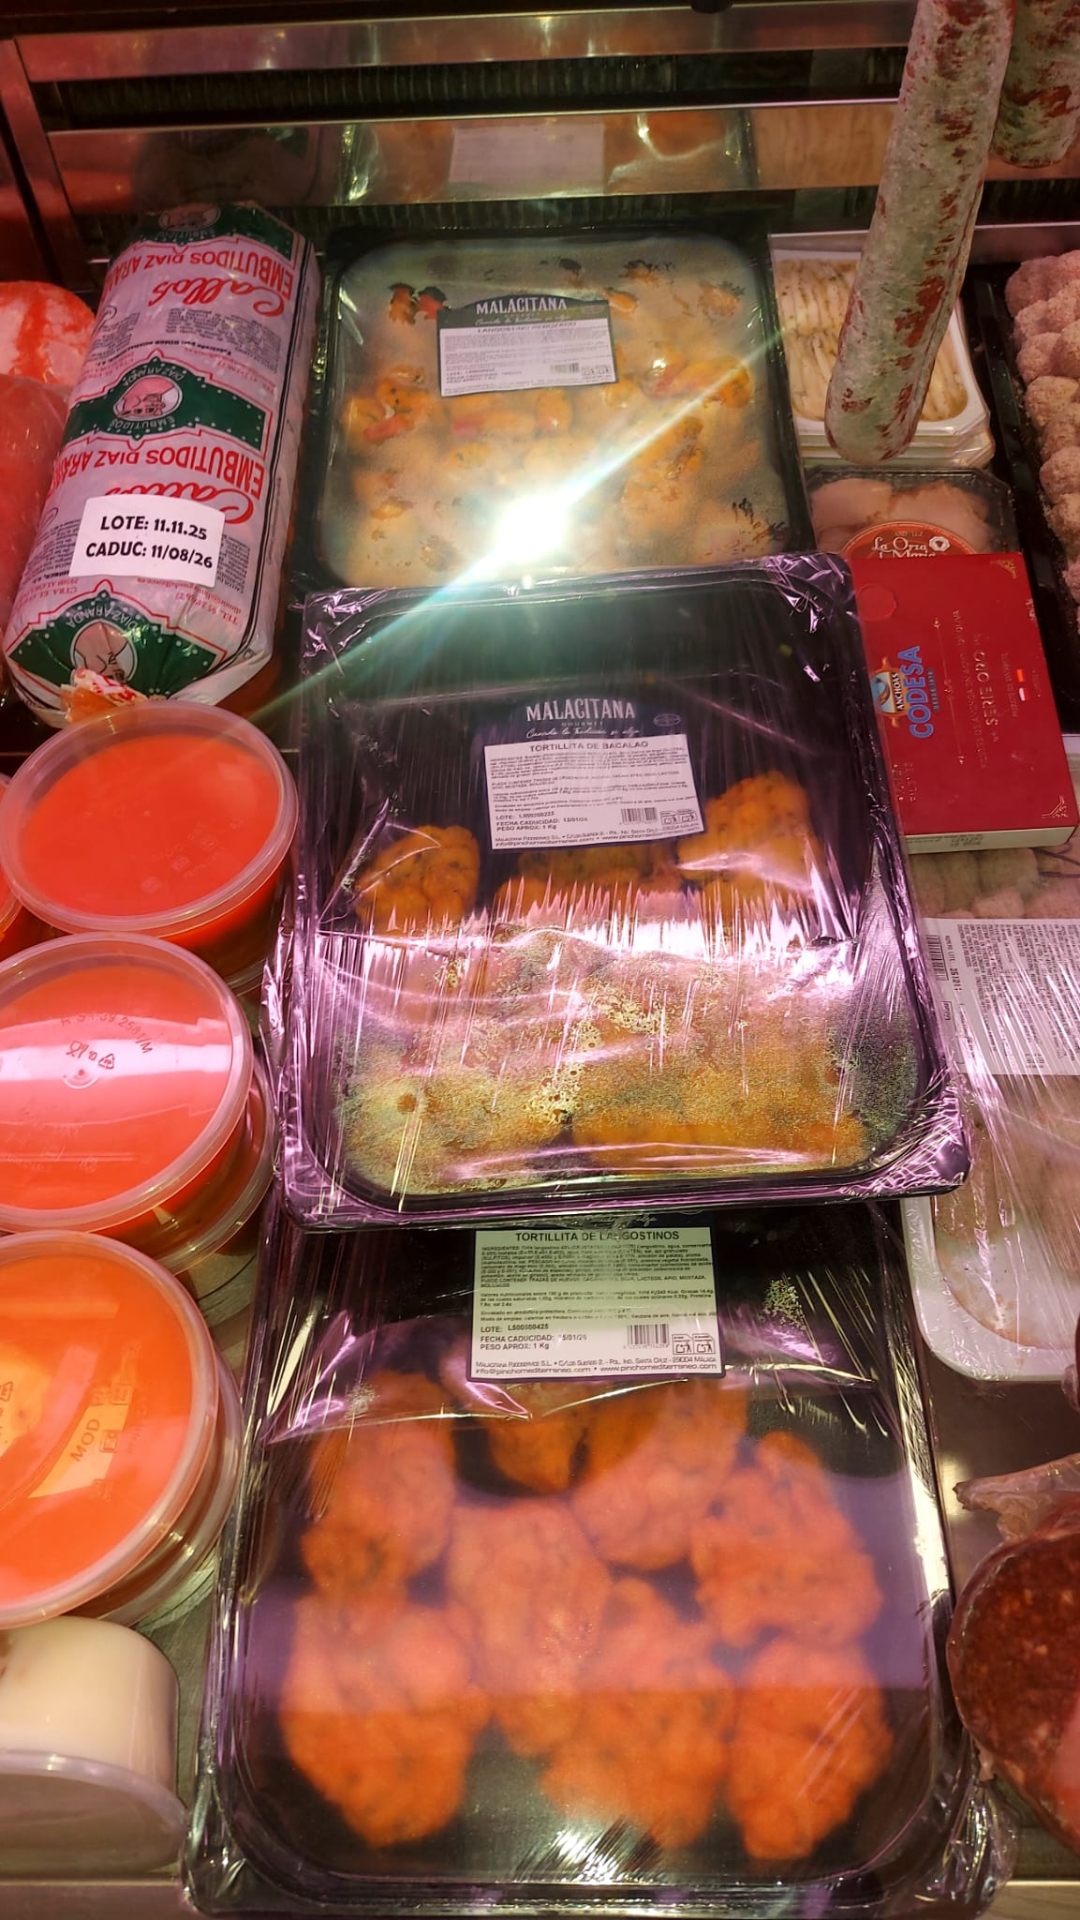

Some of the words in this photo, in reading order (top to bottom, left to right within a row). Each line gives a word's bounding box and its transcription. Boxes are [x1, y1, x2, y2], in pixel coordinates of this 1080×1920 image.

[144, 254, 184, 269] DIAZ
[190, 250, 293, 299] EMBUTIDOS
[148, 278, 285, 317] Callos
[476, 296, 567, 315] MALACITANA
[109, 415, 175, 430] EMBUTIDOS
[95, 449, 140, 469] DIAZ
[145, 447, 265, 500] EMBUTIDOS
[100, 515, 149, 532] LOTE:
[153, 518, 208, 541] 11.11.25
[86, 541, 147, 558] CADUC:
[152, 544, 213, 569] 11/08/26
[872, 536, 888, 551] La
[65, 604, 113, 628] ARANDA
[973, 651, 990, 683] ORO
[888, 671, 906, 711] ANCHOAS
[897, 645, 934, 739] CODESA
[525, 698, 636, 722] MALACITANA
[979, 687, 998, 726] SERIE
[530, 743, 584, 753] TORTILLITA
[586, 742, 601, 750] DE
[603, 741, 649, 750] BACALAO
[516, 1231, 579, 1242] TORTILLITA
[581, 1231, 597, 1241] DE
[480, 1325, 502, 1334] LOTE:
[480, 1335, 506, 1344] FECHA
[507, 1334, 555, 1343] CADUCIDAD:
[480, 1343, 502, 1351] PESO
[503, 1343, 532, 1351] APROX:
[538, 1343, 550, 1352] Kg
[70, 1418, 102, 1463] MOD
